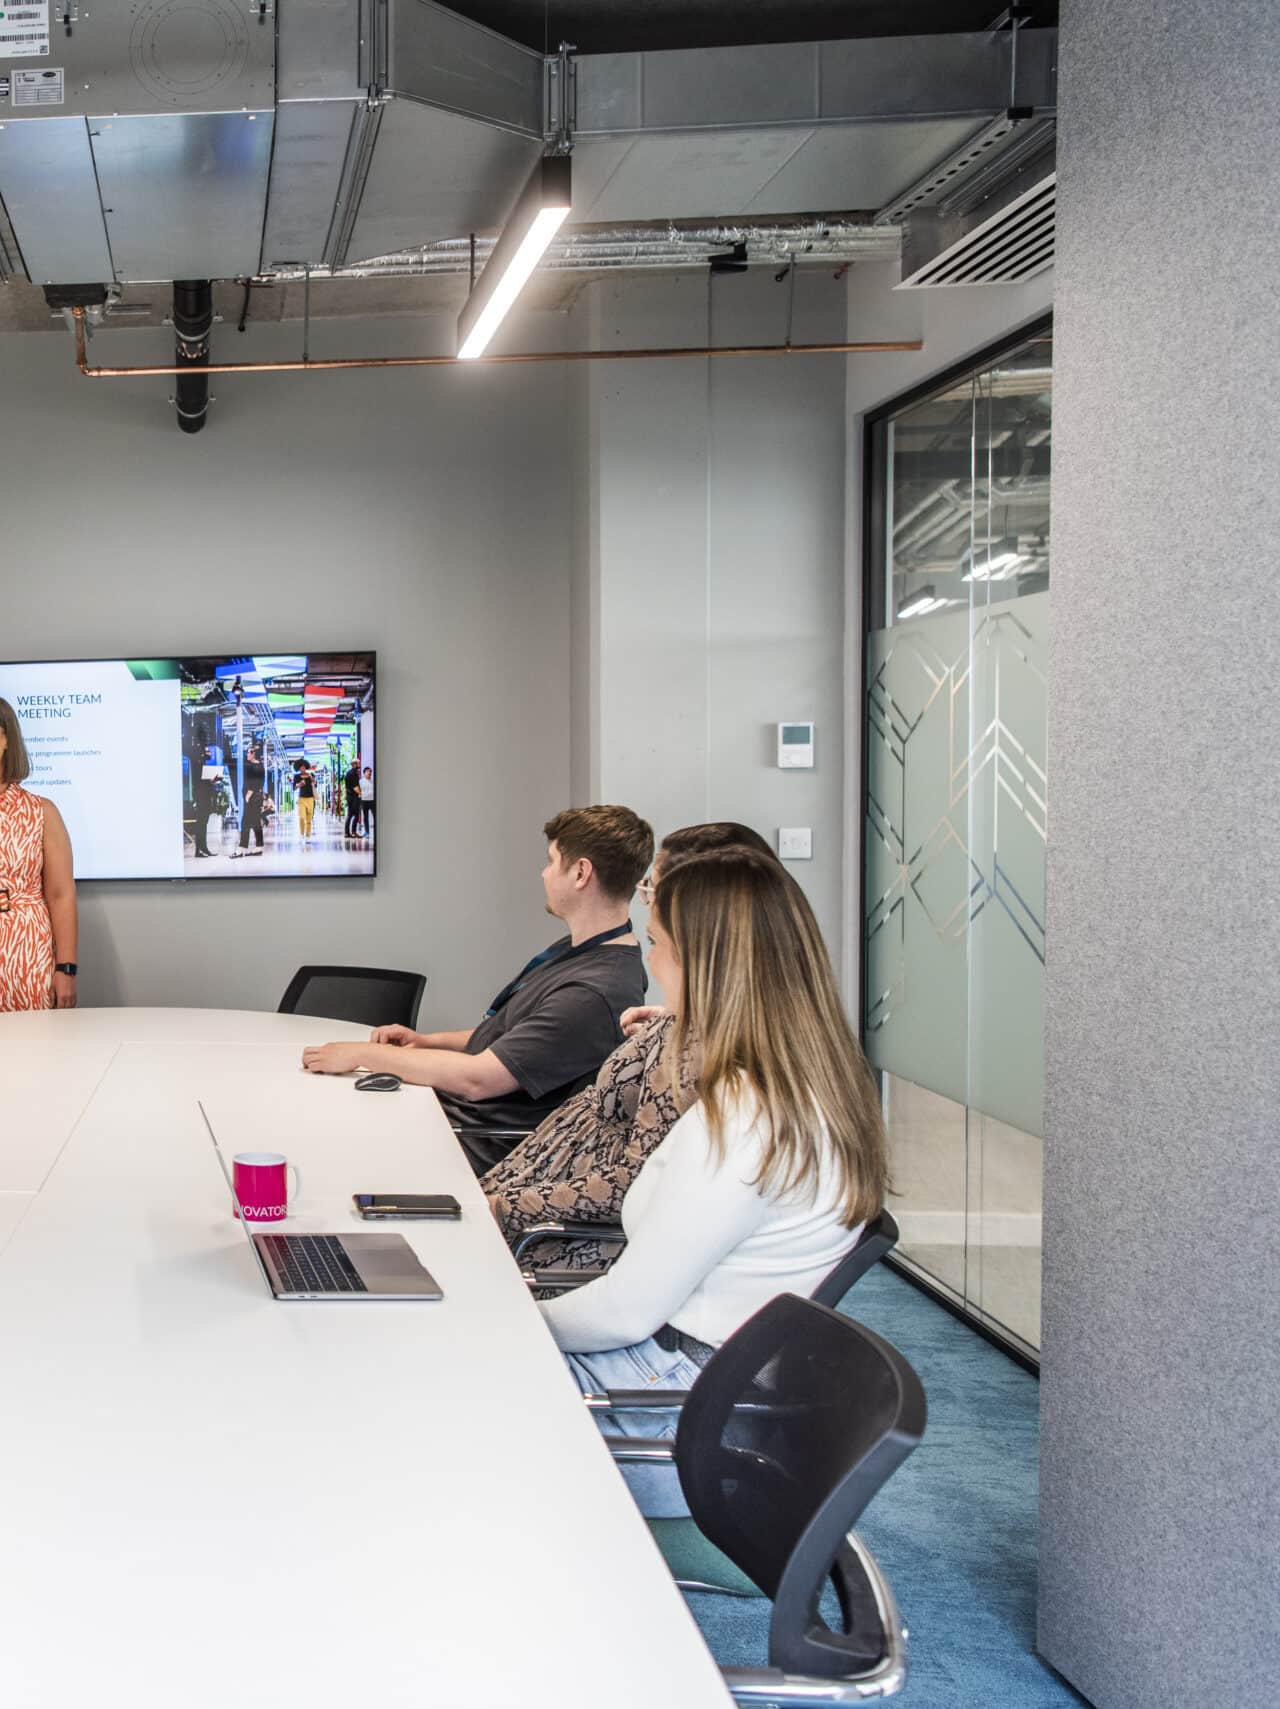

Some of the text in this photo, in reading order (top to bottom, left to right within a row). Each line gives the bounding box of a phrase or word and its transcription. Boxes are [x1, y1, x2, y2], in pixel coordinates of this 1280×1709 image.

[17, 694, 102, 706] WEEKLY TEAM
[17, 708, 72, 719] MEETING
[45, 778, 71, 786] updates
